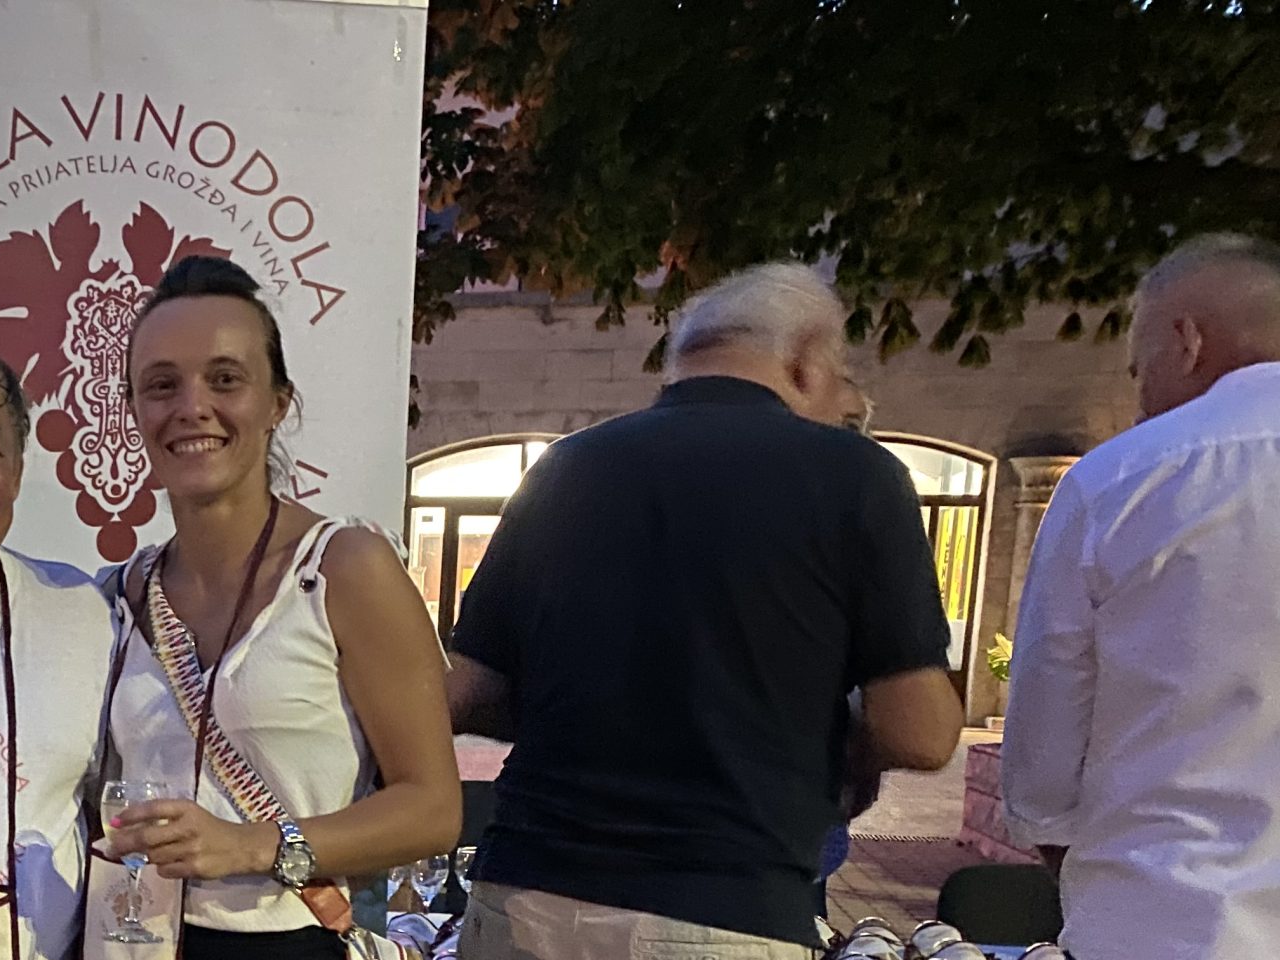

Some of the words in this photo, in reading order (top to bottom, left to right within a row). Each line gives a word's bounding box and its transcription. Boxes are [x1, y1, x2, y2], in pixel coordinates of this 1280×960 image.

[8, 154, 137, 199] PRIJATELJA
[145, 160, 238, 224] GROŽĐA
[240, 218, 253, 233] I
[251, 230, 290, 296] VINA
[61, 91, 346, 325] VINODOLA
